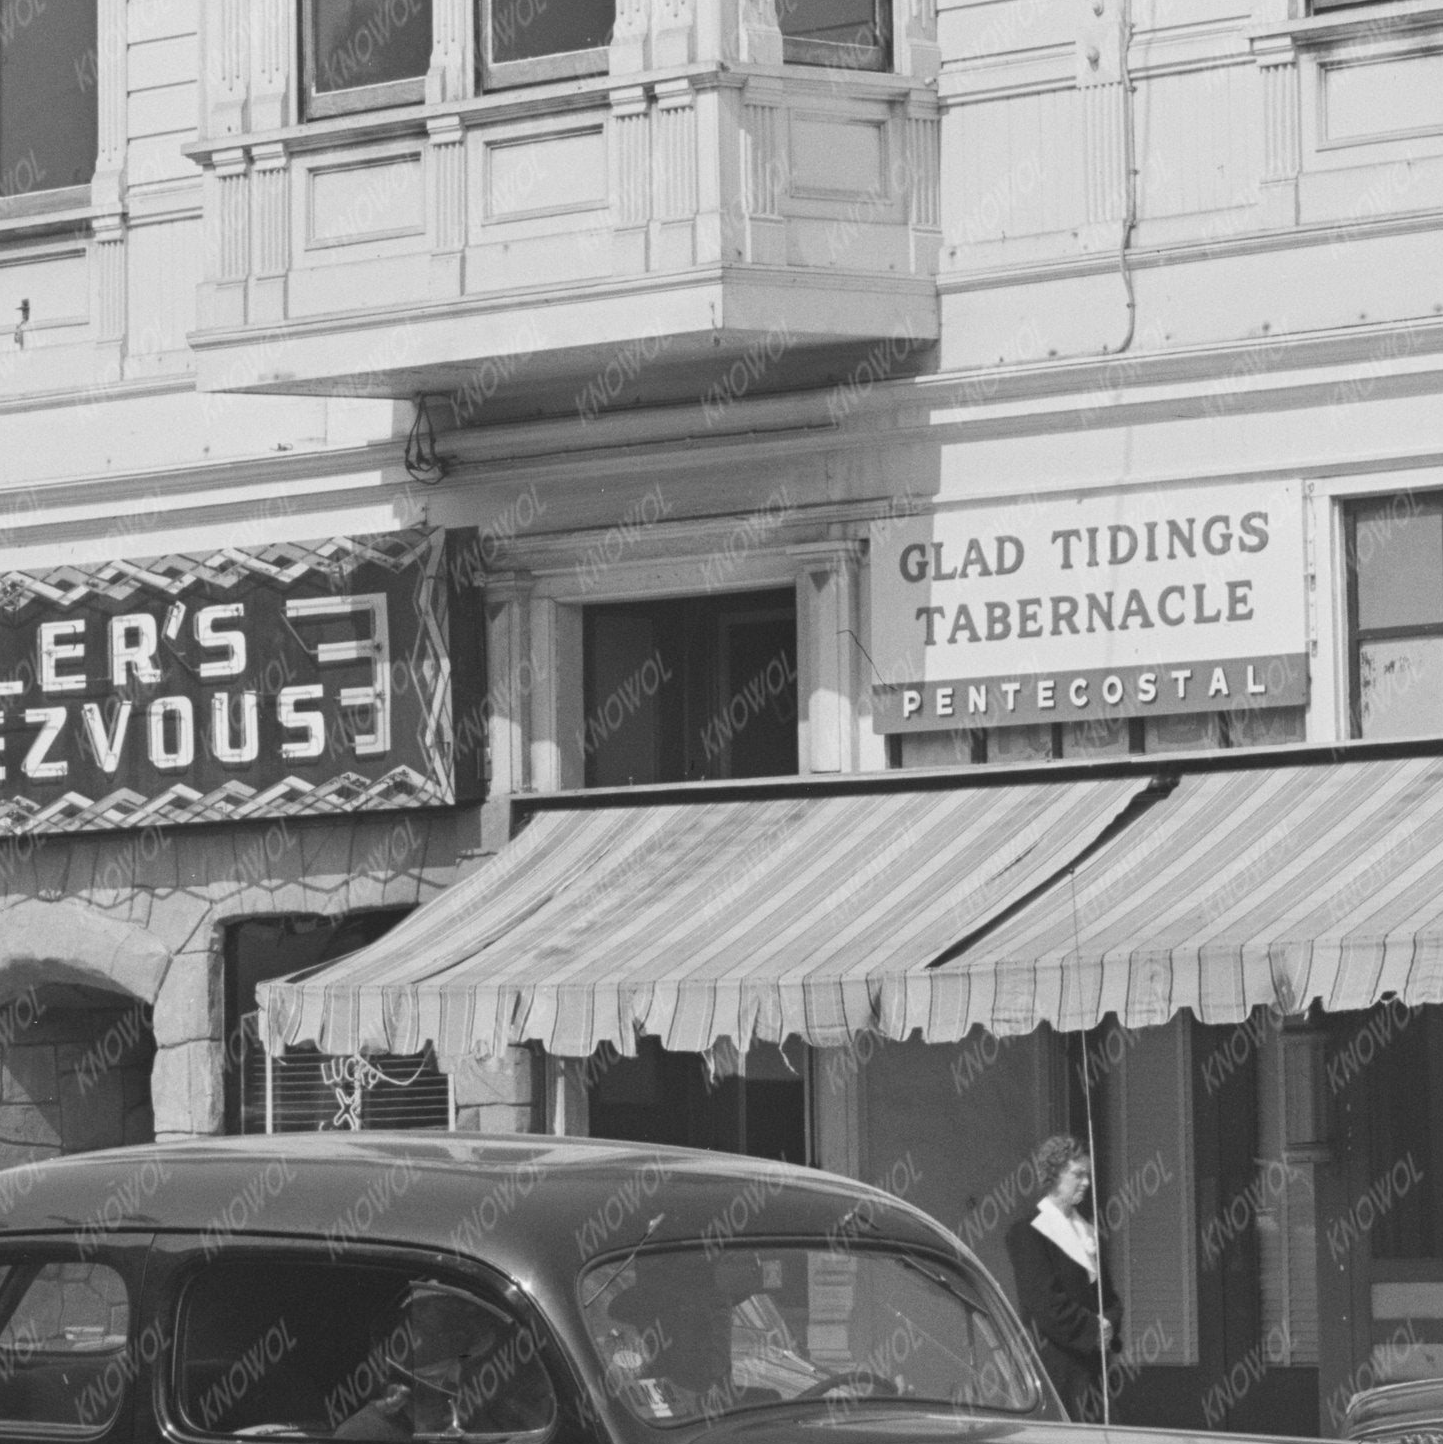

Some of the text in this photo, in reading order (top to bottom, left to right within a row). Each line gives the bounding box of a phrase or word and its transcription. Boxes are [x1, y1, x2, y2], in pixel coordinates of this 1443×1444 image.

[899, 511, 1270, 583] GLAD TIDINGS
[916, 580, 1254, 646] TABERNACLE
[903, 665, 1266, 718] PENTECOSTAL
